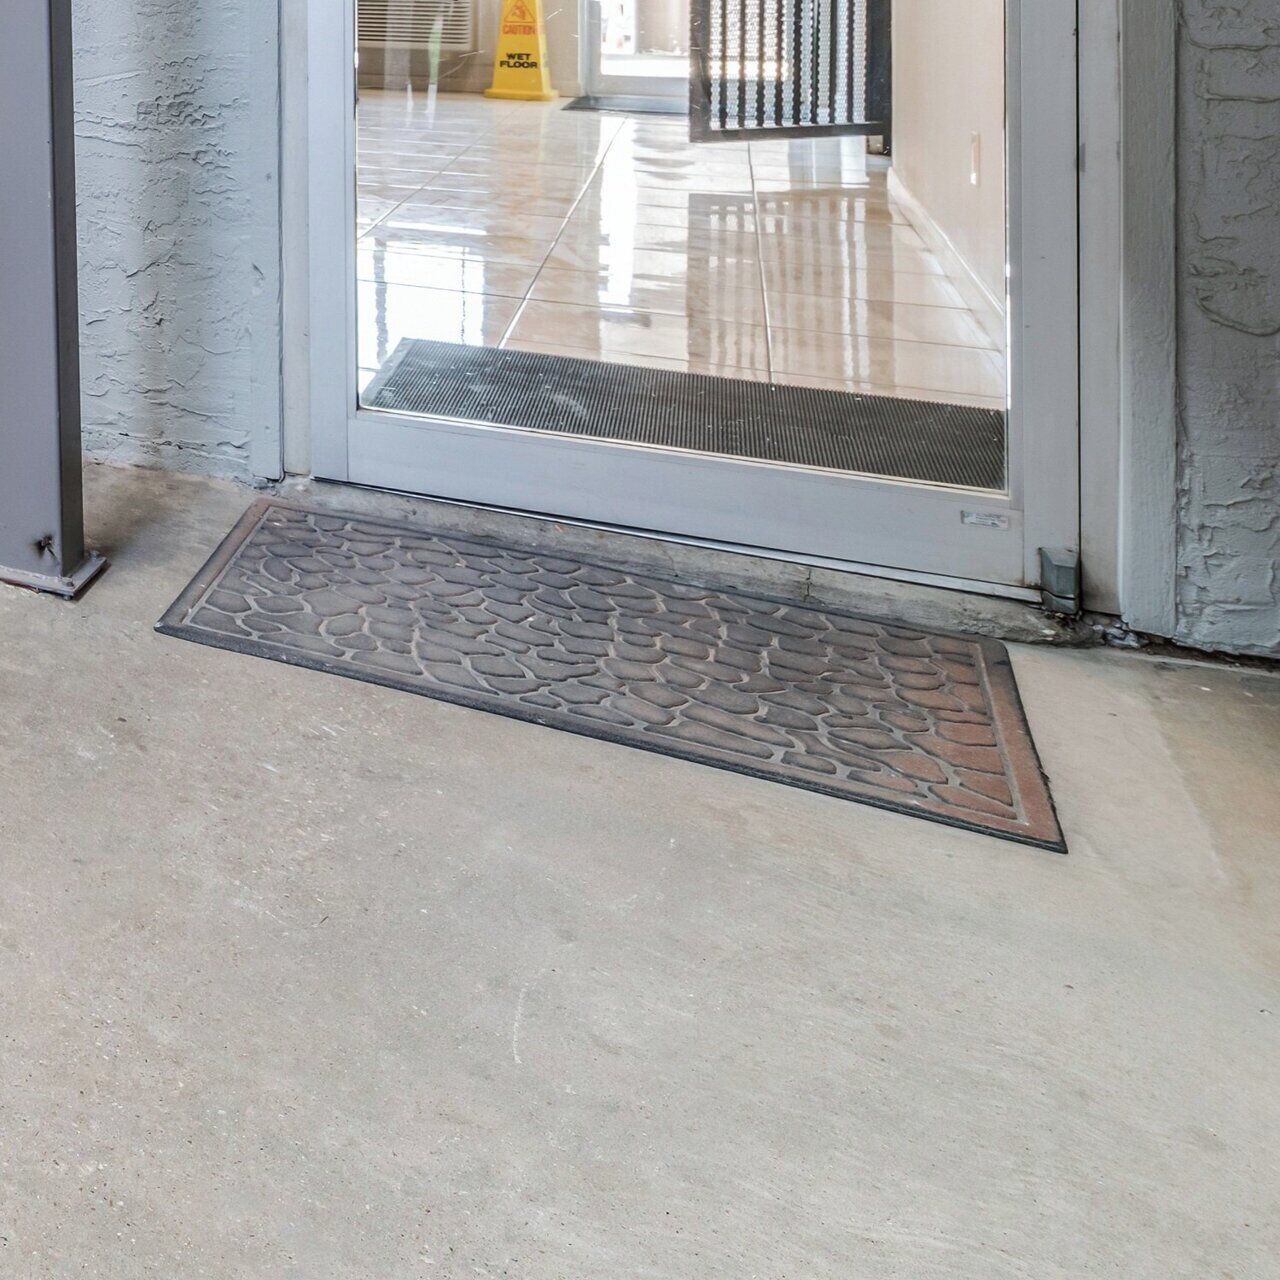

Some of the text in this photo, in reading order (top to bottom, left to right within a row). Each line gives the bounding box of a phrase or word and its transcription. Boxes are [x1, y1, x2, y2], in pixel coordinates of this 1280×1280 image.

[503, 24, 535, 36] CAUTION
[506, 53, 531, 61] WET
[500, 61, 537, 69] FLOOR
